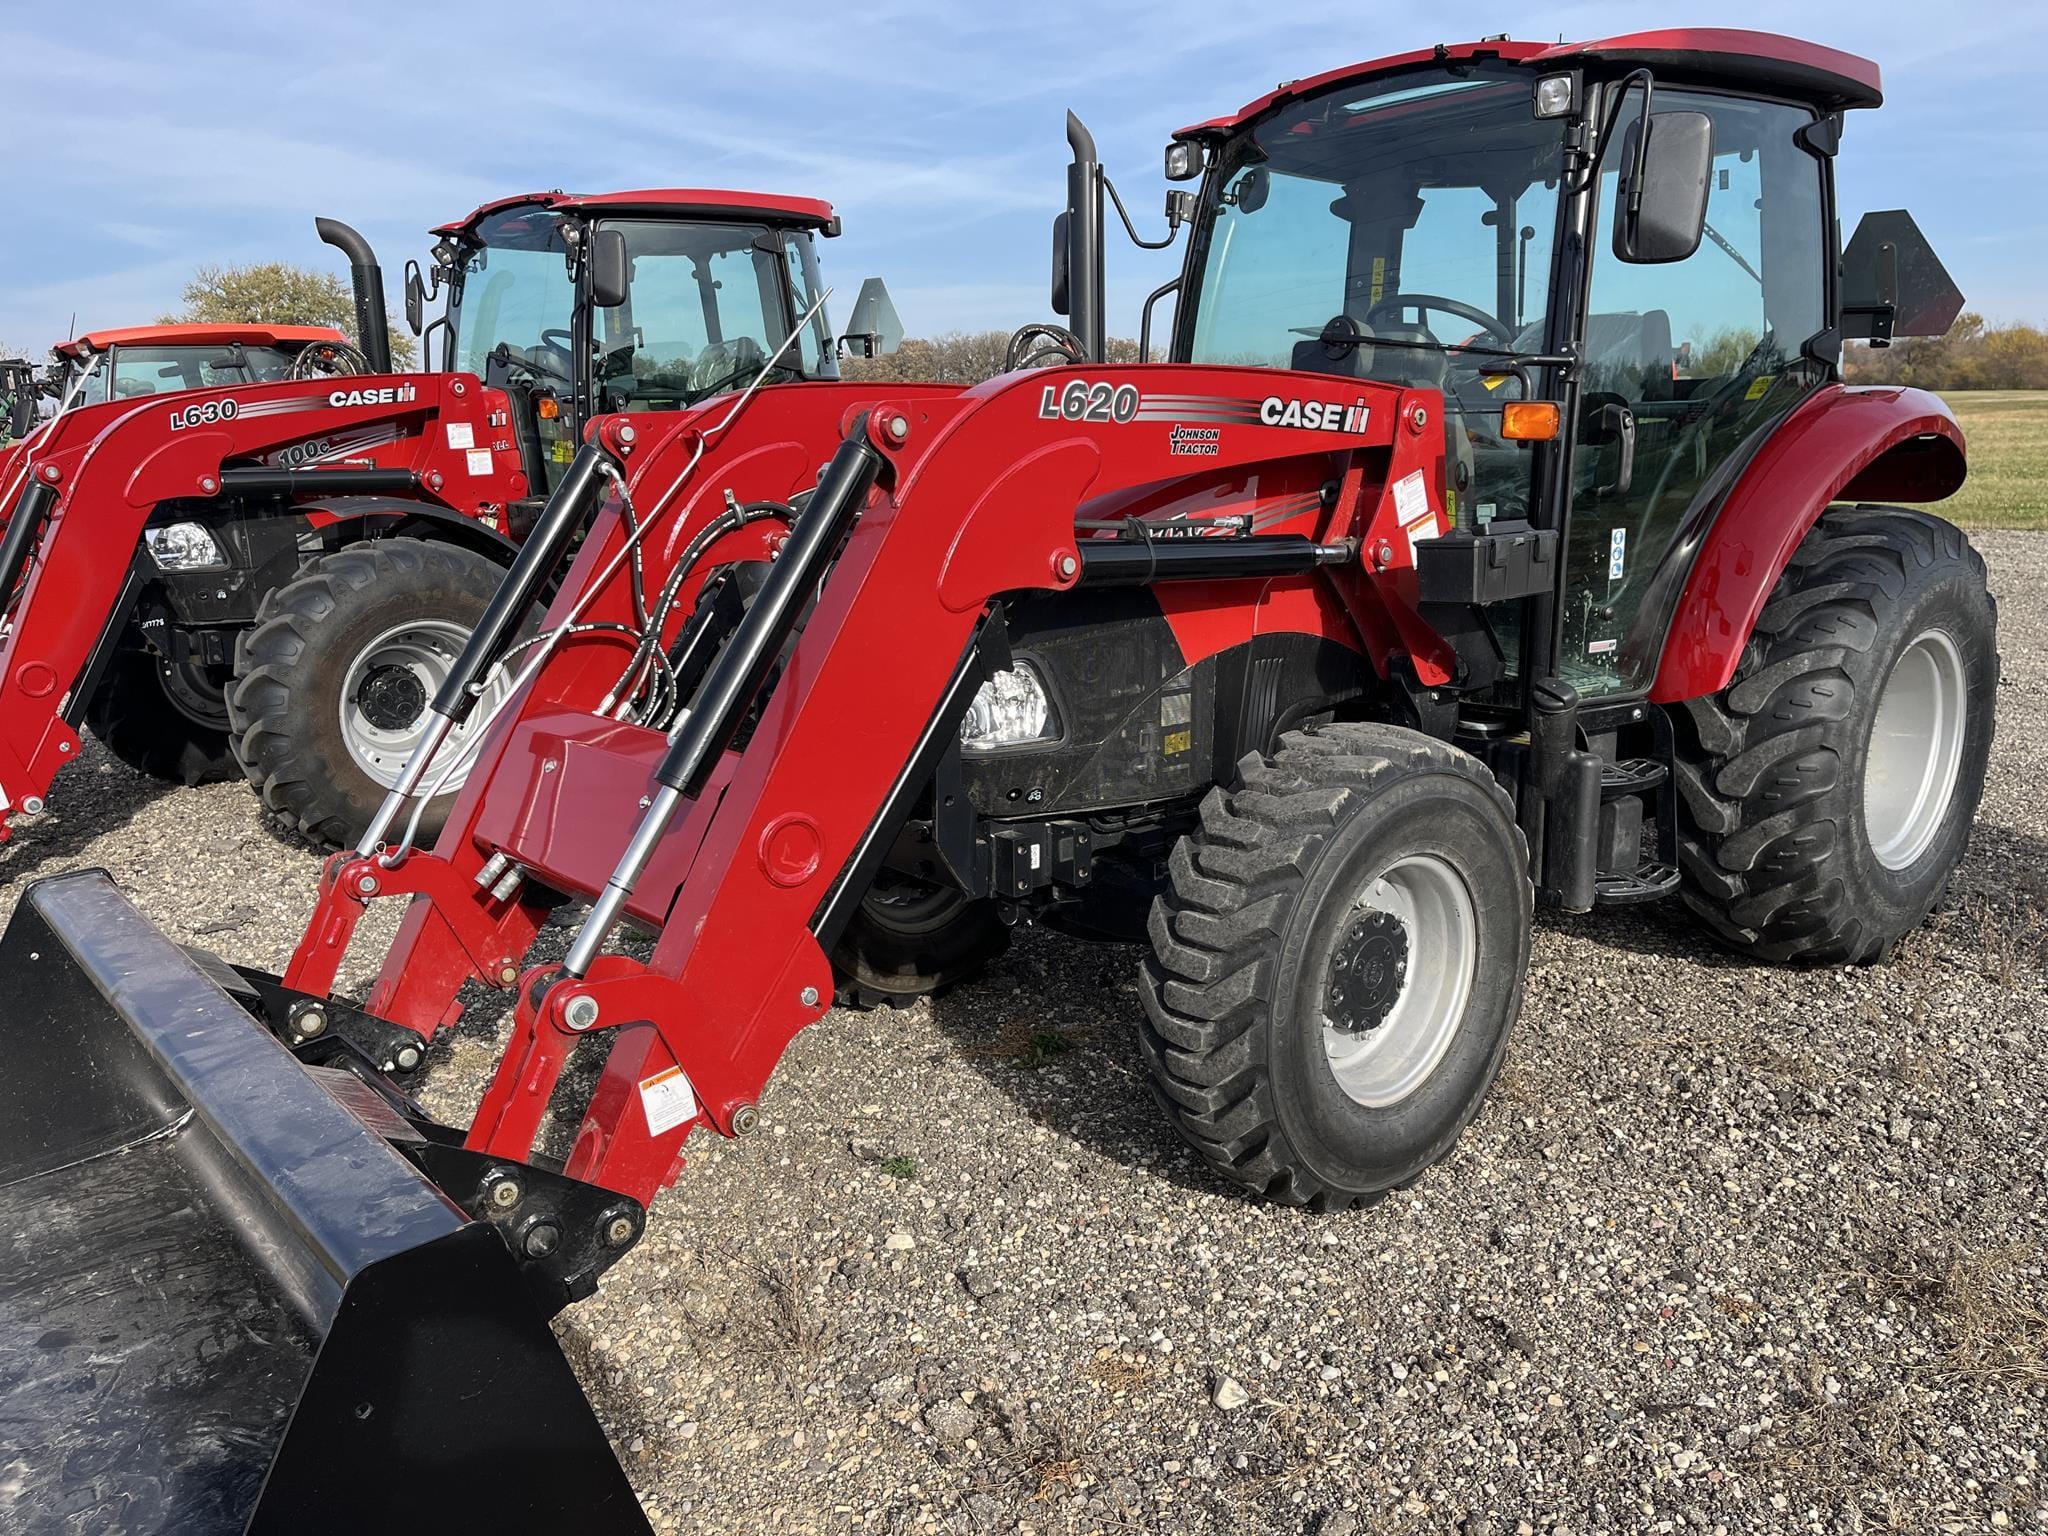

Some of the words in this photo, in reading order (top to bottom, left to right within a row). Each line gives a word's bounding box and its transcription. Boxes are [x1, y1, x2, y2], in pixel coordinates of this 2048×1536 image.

[329, 387, 394, 407] CASE
[1039, 379, 1139, 424] L620
[1259, 396, 1343, 431] CASE
[170, 399, 238, 431] L630
